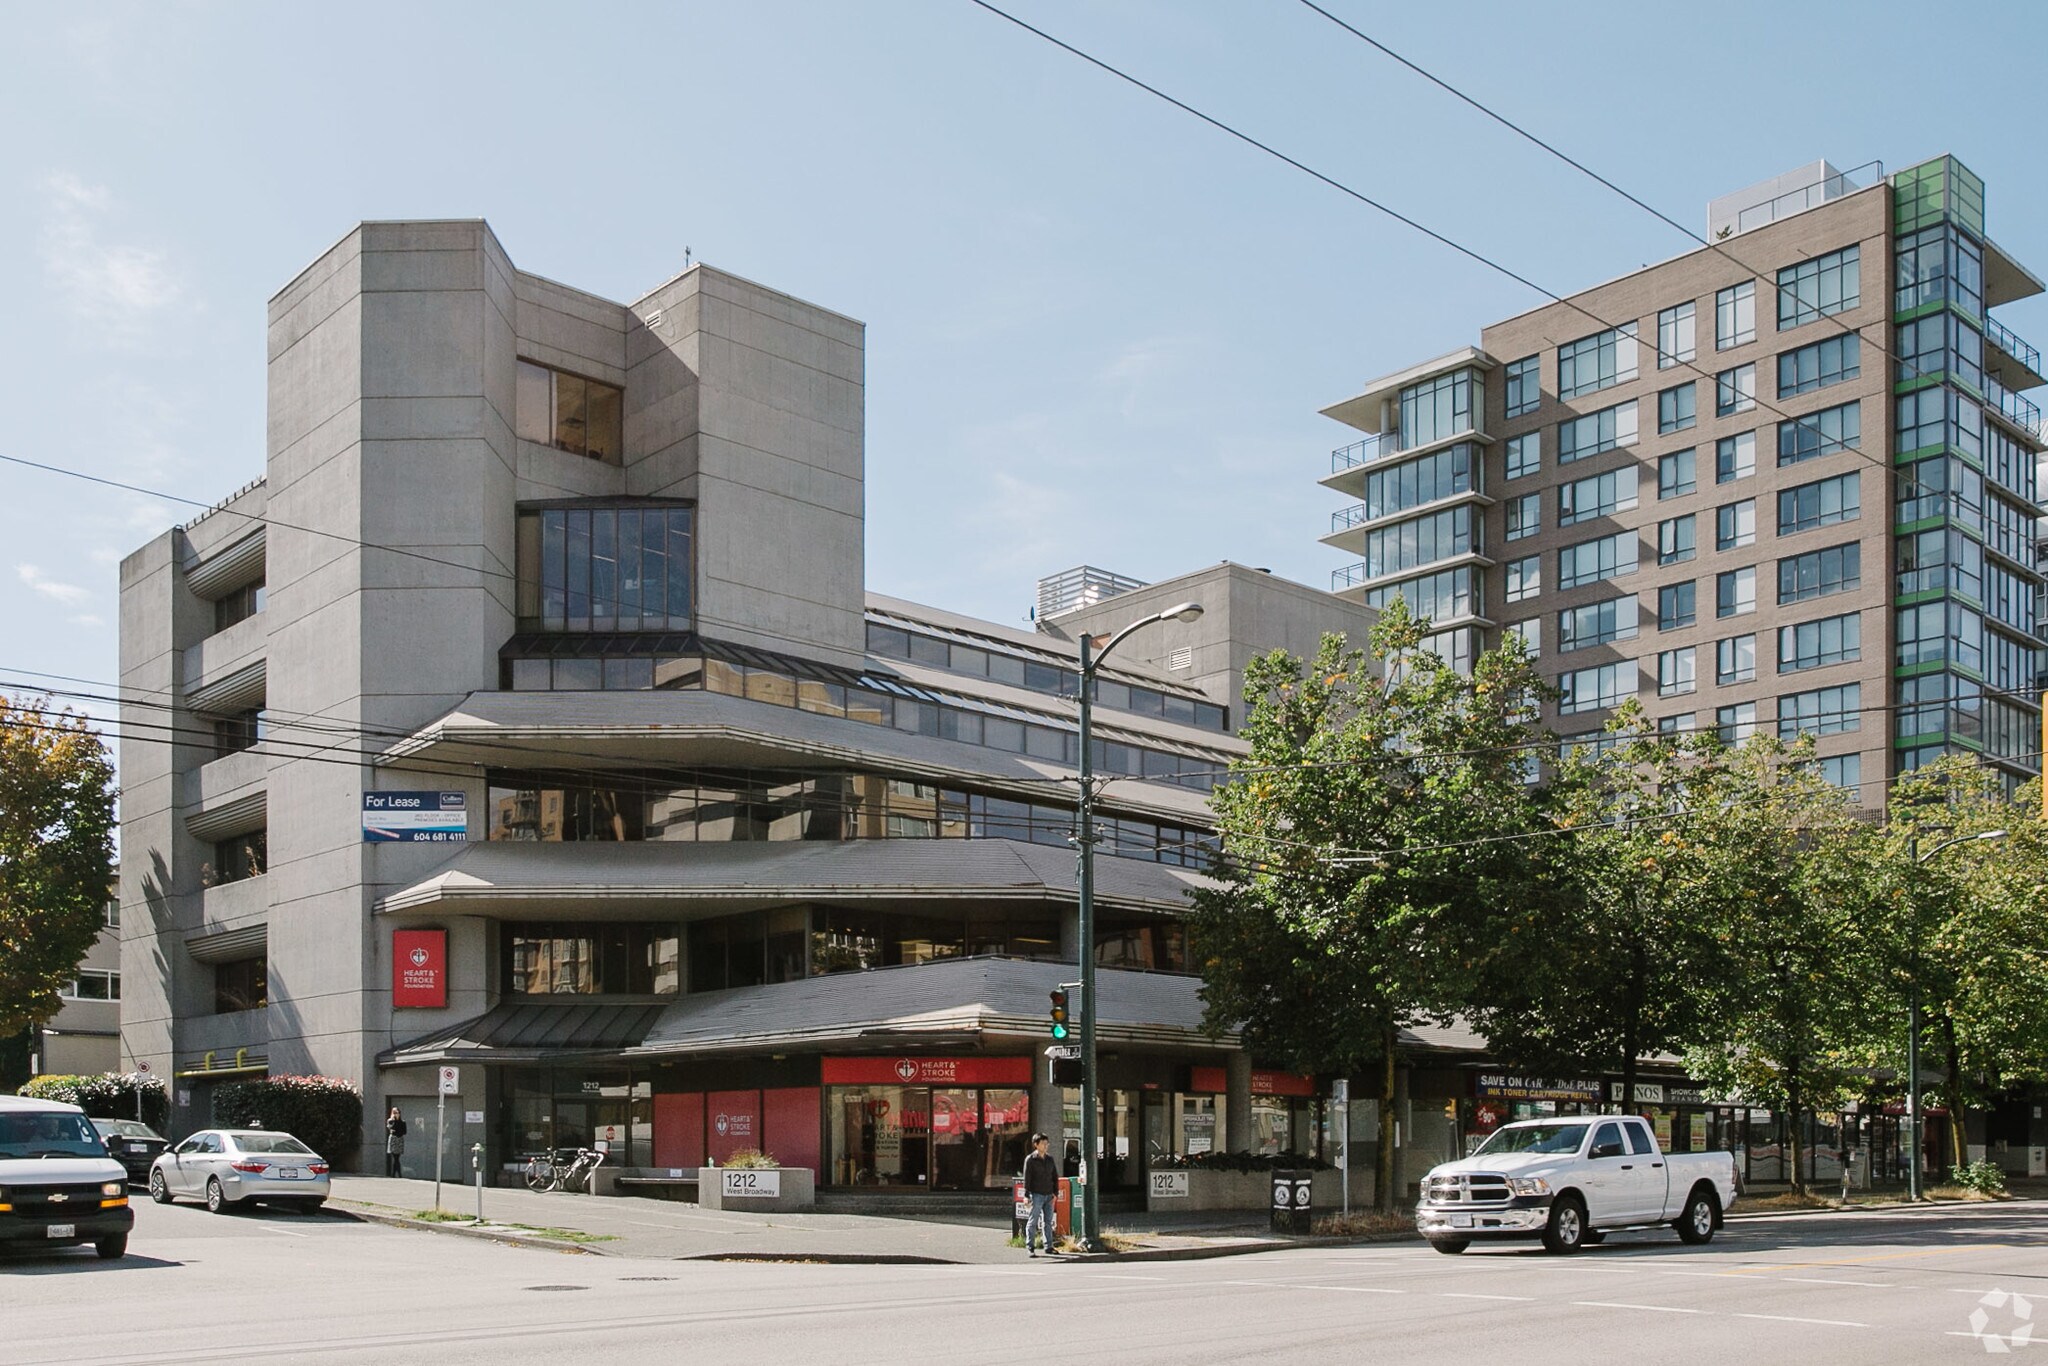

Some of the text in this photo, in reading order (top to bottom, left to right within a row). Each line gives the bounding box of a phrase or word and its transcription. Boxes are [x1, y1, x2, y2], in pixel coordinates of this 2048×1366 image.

[366, 796, 421, 807] For Lease
[414, 832, 466, 841] 604 681 4111
[403, 976, 435, 984] STROKE
[921, 1069, 956, 1077] STROKE
[582, 1082, 600, 1090] 1212
[1480, 1075, 1506, 1086] SAVE
[1507, 1076, 1522, 1087] ON
[1576, 1080, 1600, 1091] PLUS
[1487, 1087, 1500, 1096] INK
[1502, 1088, 1527, 1097] TONER
[1615, 1085, 1659, 1099] PNOS
[1670, 1088, 1701, 1096] SHOWCAS
[726, 1173, 757, 1188] 1212
[1153, 1174, 1174, 1188] 1212
[744, 1188, 776, 1196] Broadway
